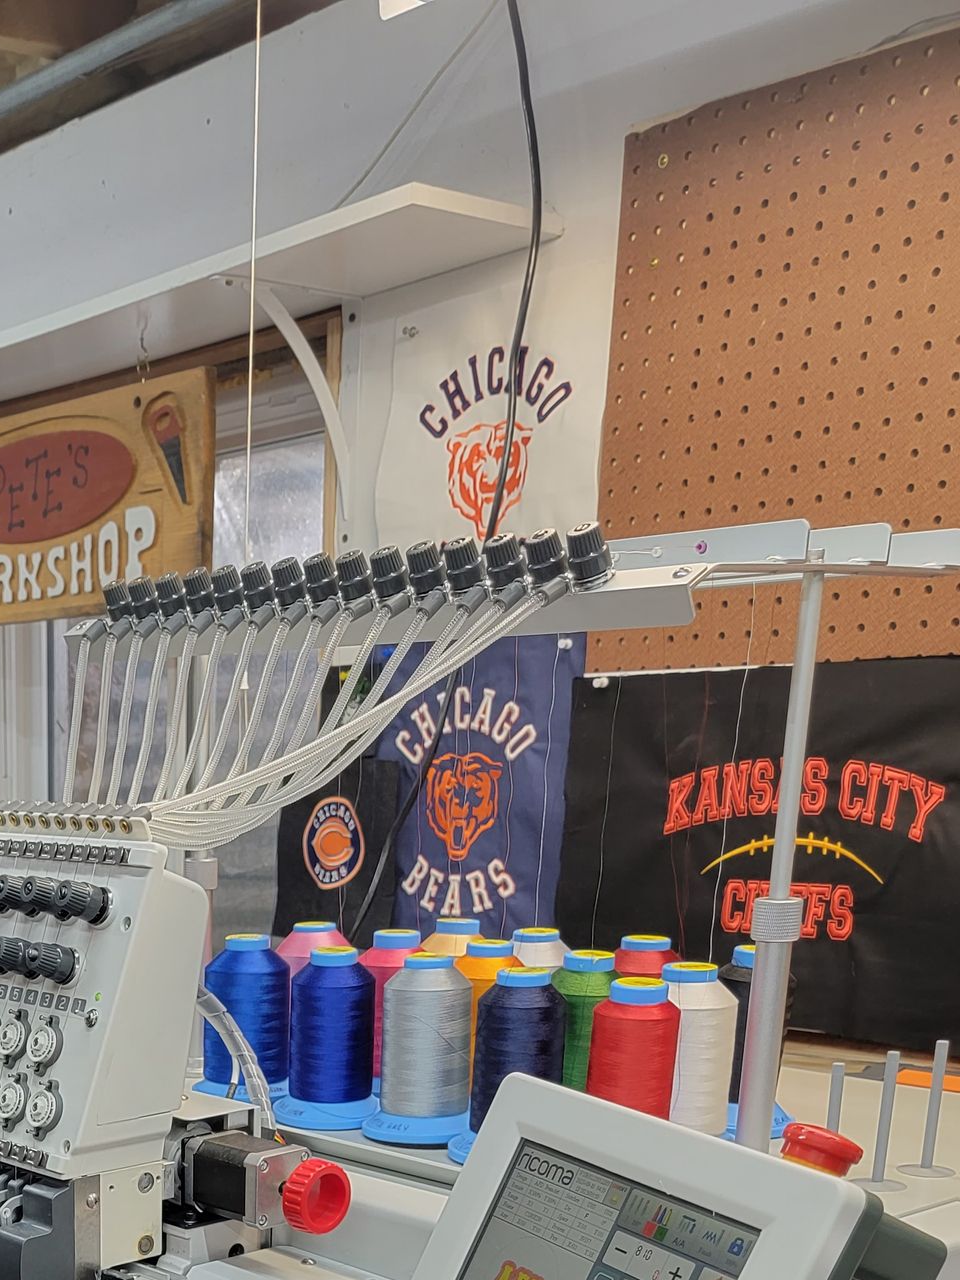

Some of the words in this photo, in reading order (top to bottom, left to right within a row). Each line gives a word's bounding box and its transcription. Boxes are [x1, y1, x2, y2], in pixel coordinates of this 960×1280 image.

[663, 756, 828, 835] KANSS
[838, 759, 946, 843] CITY
[401, 854, 517, 916] BEARS
[518, 1151, 575, 1186] ricoma
[635, 1245, 653, 1261] 810
